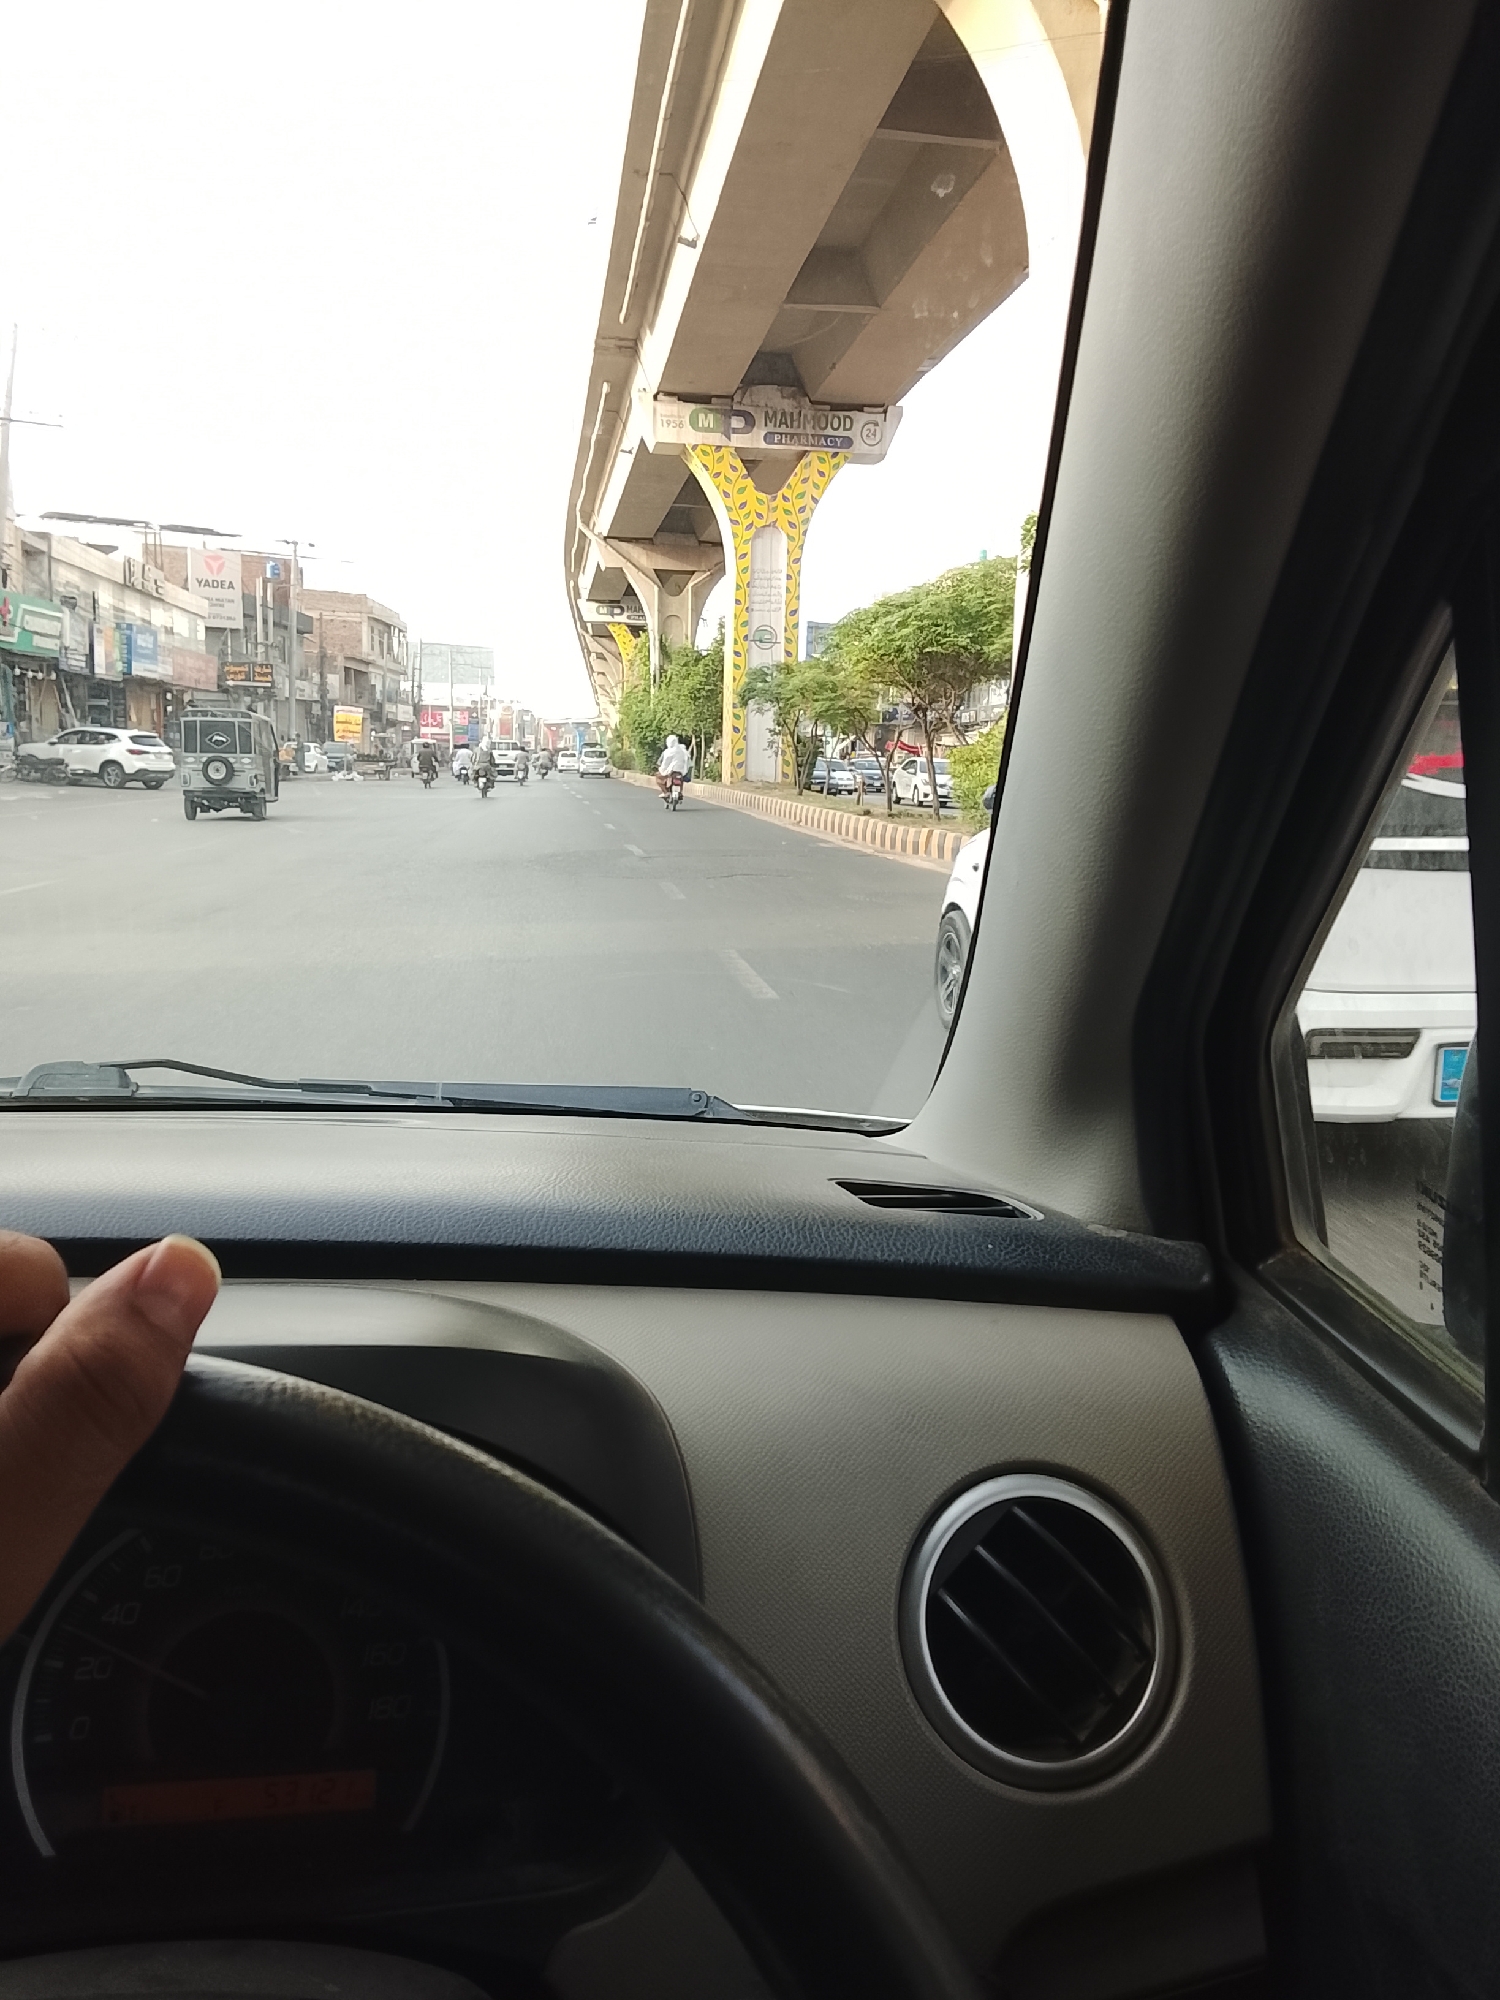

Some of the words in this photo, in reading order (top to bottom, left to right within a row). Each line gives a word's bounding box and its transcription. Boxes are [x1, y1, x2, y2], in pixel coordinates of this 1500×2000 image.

[660, 418, 685, 429] 1956
[763, 410, 854, 432] MAHMOOD
[774, 434, 844, 447] PHARMACY
[865, 427, 878, 439] 24
[195, 577, 236, 590] YADEA
[143, 1563, 183, 1589] 60
[101, 1601, 141, 1626] 40
[73, 1655, 113, 1681] 20
[69, 1716, 91, 1740] 0
